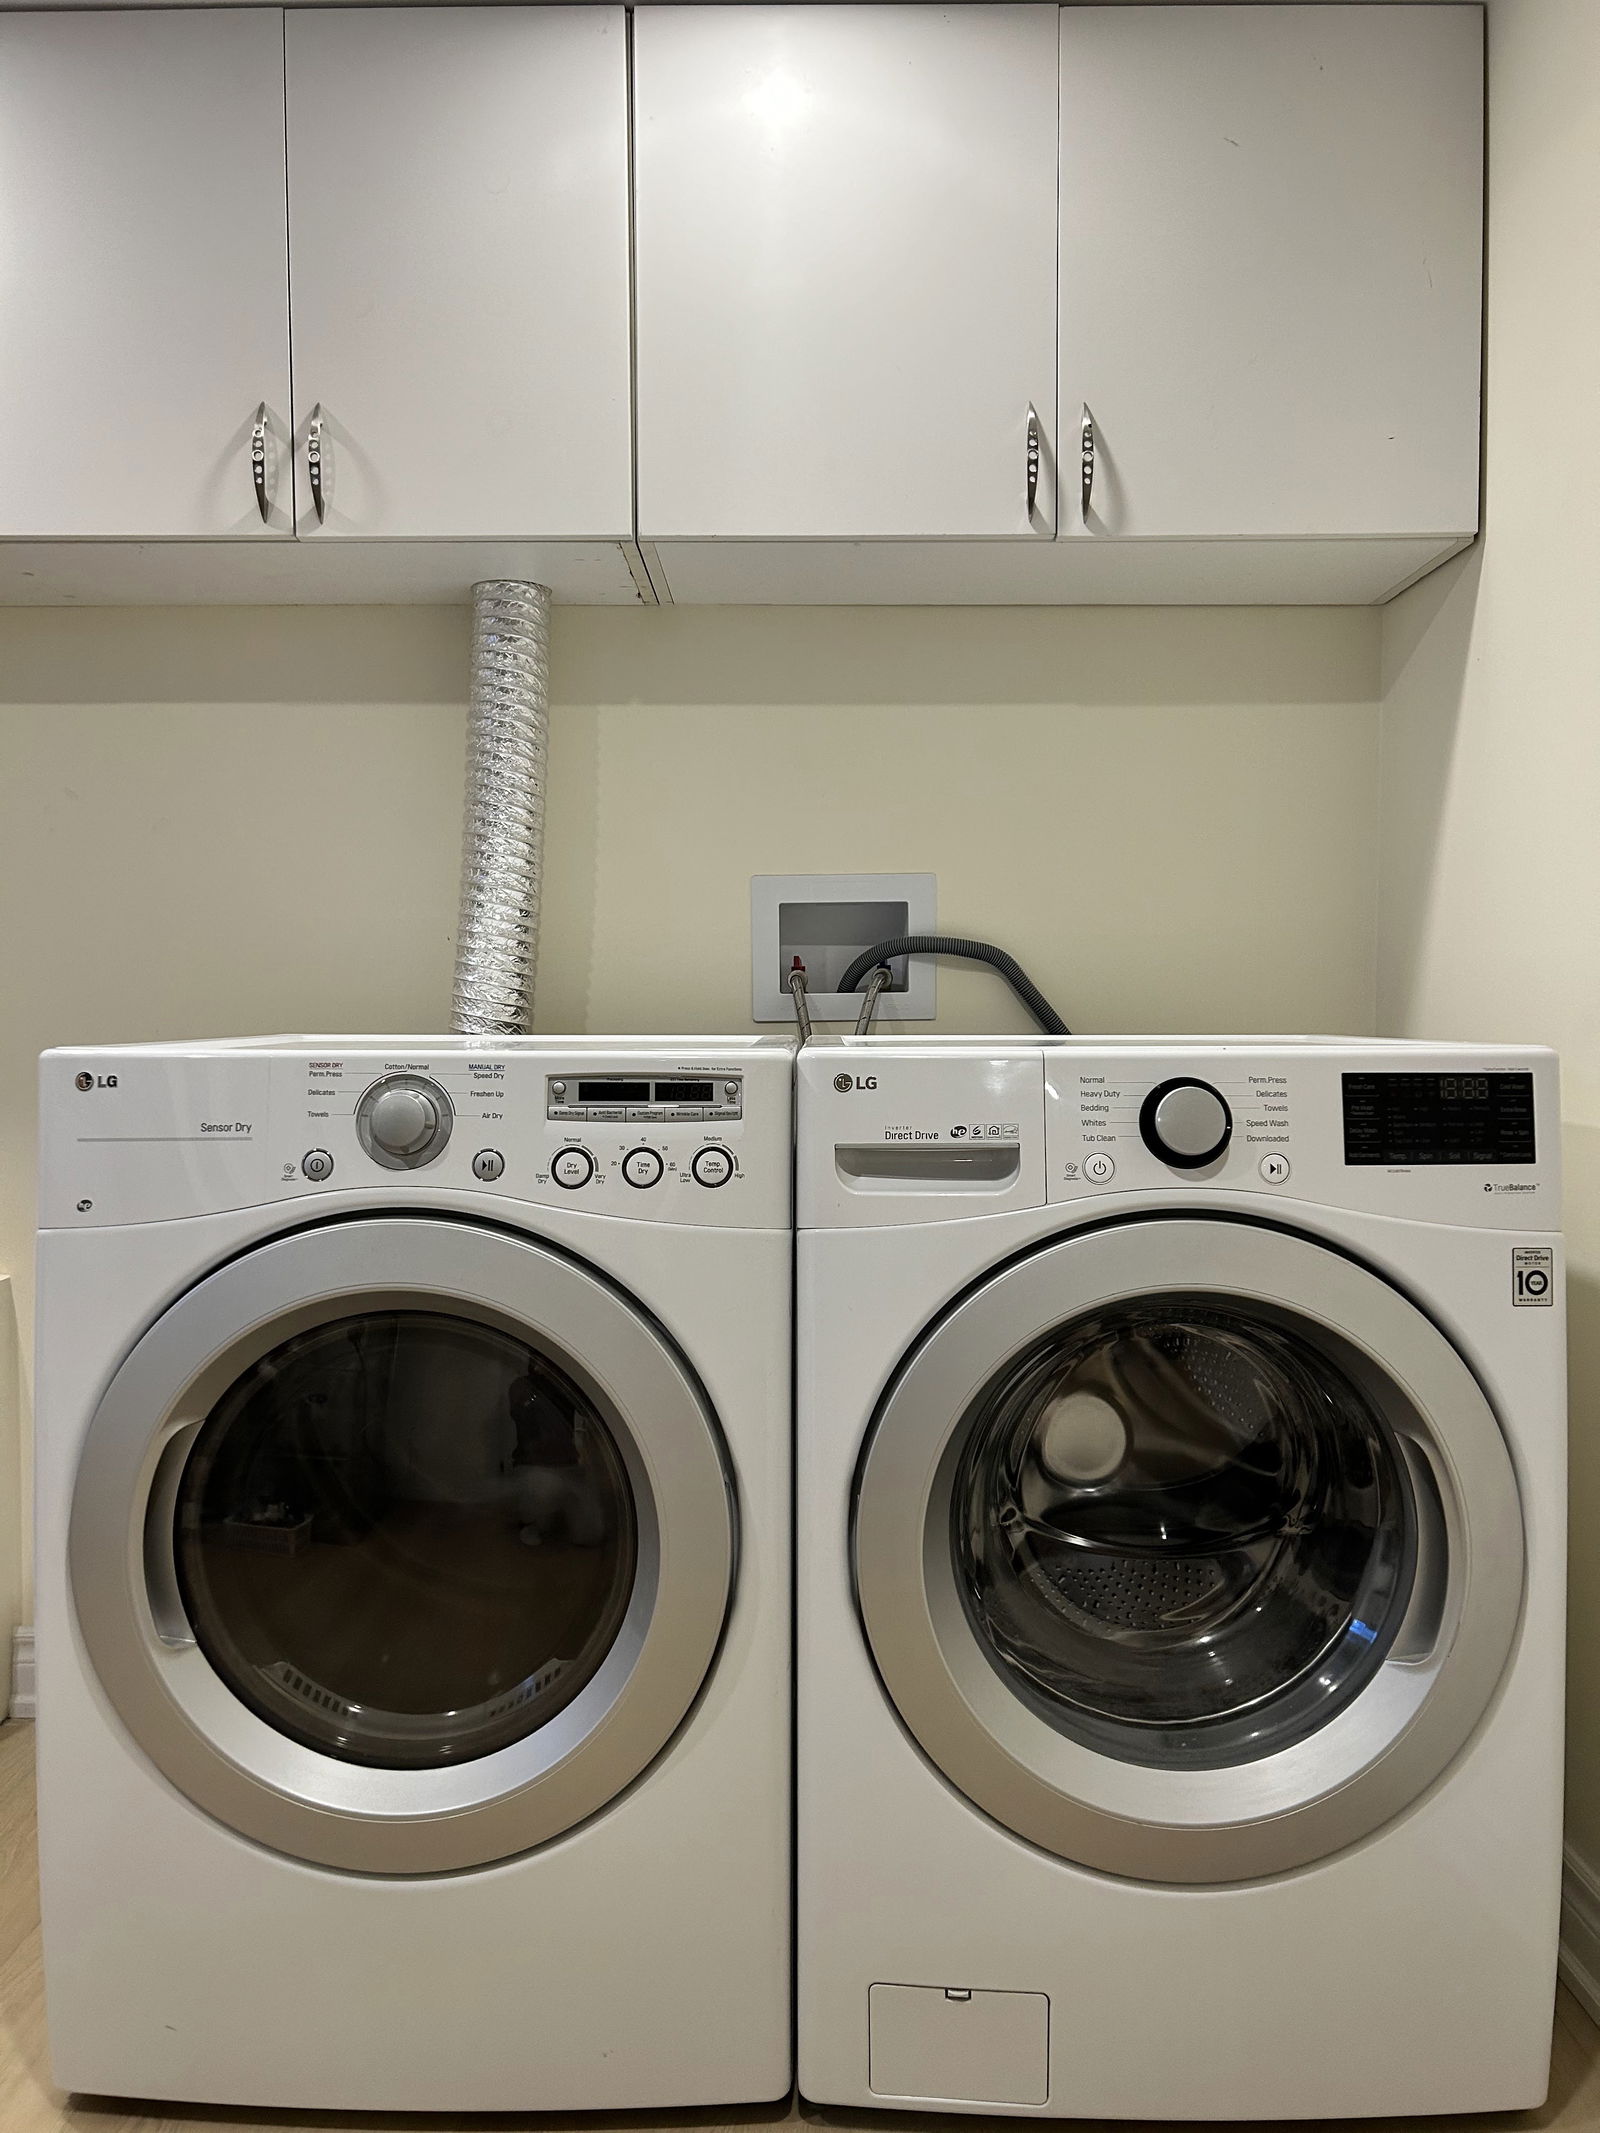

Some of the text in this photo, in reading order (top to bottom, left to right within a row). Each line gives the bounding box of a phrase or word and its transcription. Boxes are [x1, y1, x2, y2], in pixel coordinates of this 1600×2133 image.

[384, 1063, 430, 1071] Cotton/Normal
[473, 1072, 505, 1080] Speed Dry
[1079, 1076, 1105, 1084] Normal
[97, 1075, 118, 1088] LG
[856, 1076, 877, 1090] LG
[470, 1090, 505, 1098] Freshen Up
[1080, 1090, 1120, 1098] Heavy Duty
[1256, 1090, 1288, 1098] Delicates
[1080, 1104, 1109, 1112] Bedding
[1263, 1104, 1289, 1112] Towels
[491, 1112, 504, 1120] Dry
[1081, 1119, 1107, 1127] Whites
[1246, 1119, 1289, 1128] Speed Wash
[200, 1122, 253, 1134] Sensor Dry
[884, 1131, 939, 1140] Direct Drive
[1082, 1134, 1116, 1142] Tub Clean
[1246, 1134, 1290, 1142] Downloaded
[637, 1167, 649, 1175] Dry
[1516, 1269, 1549, 1296] 10
